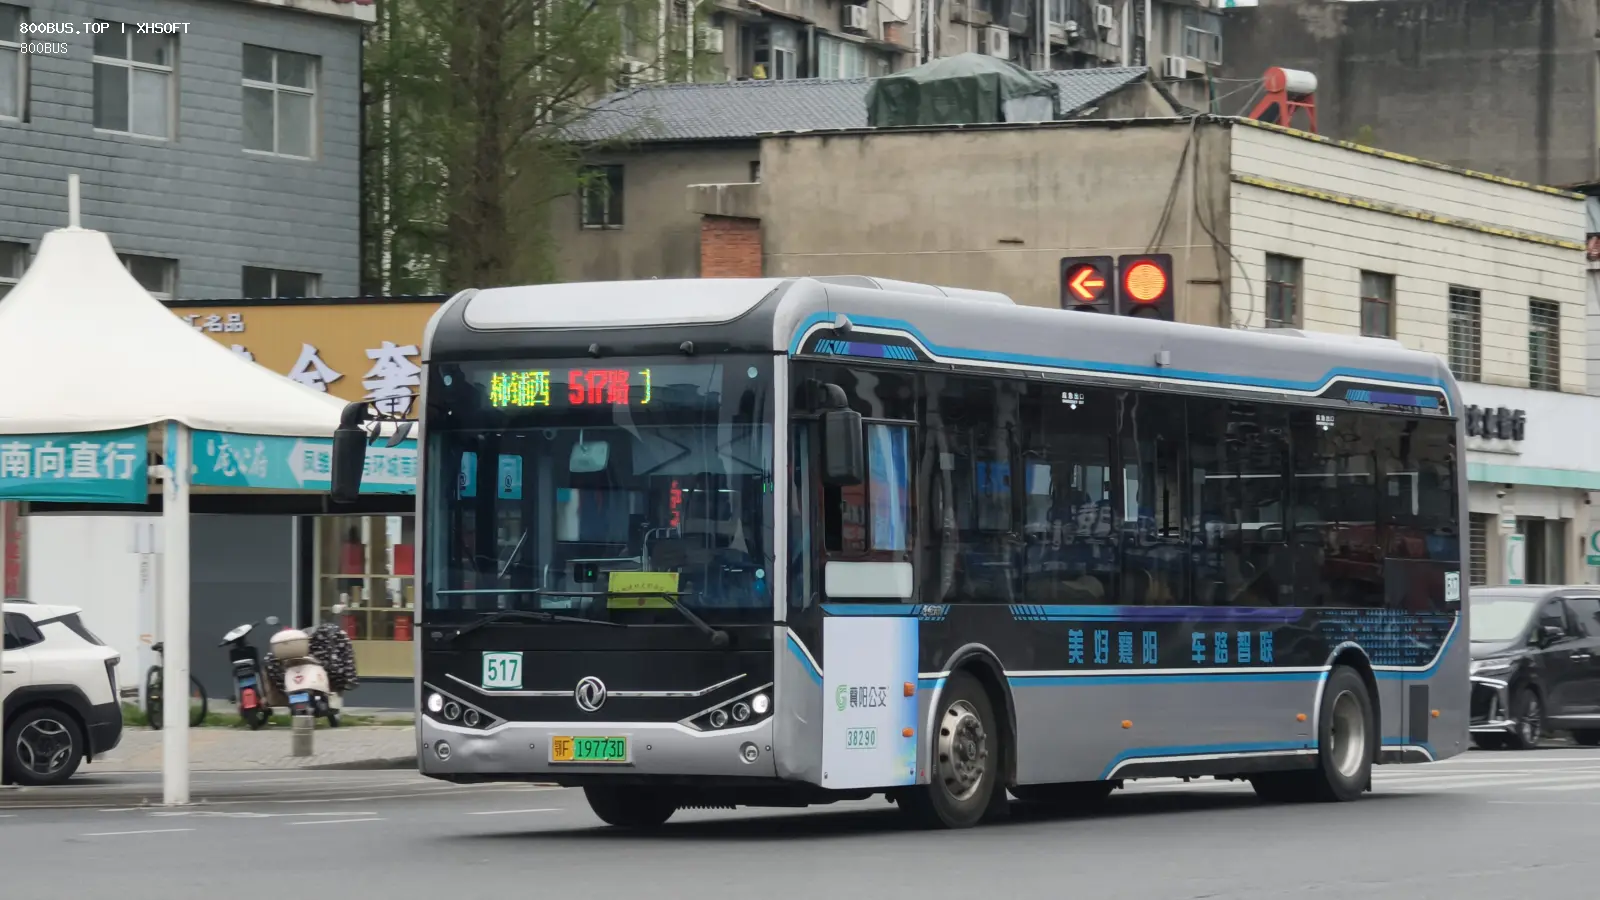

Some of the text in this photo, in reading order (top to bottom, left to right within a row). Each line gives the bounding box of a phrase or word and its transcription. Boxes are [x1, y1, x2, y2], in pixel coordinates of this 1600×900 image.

[567, 368, 629, 405] 517路
[0, 441, 136, 479] 南向直行
[1068, 629, 1273, 665] 美好襄阳 车路智联
[487, 658, 518, 682] 517
[849, 686, 887, 708] 襄阳公交
[847, 729, 876, 746] 38290
